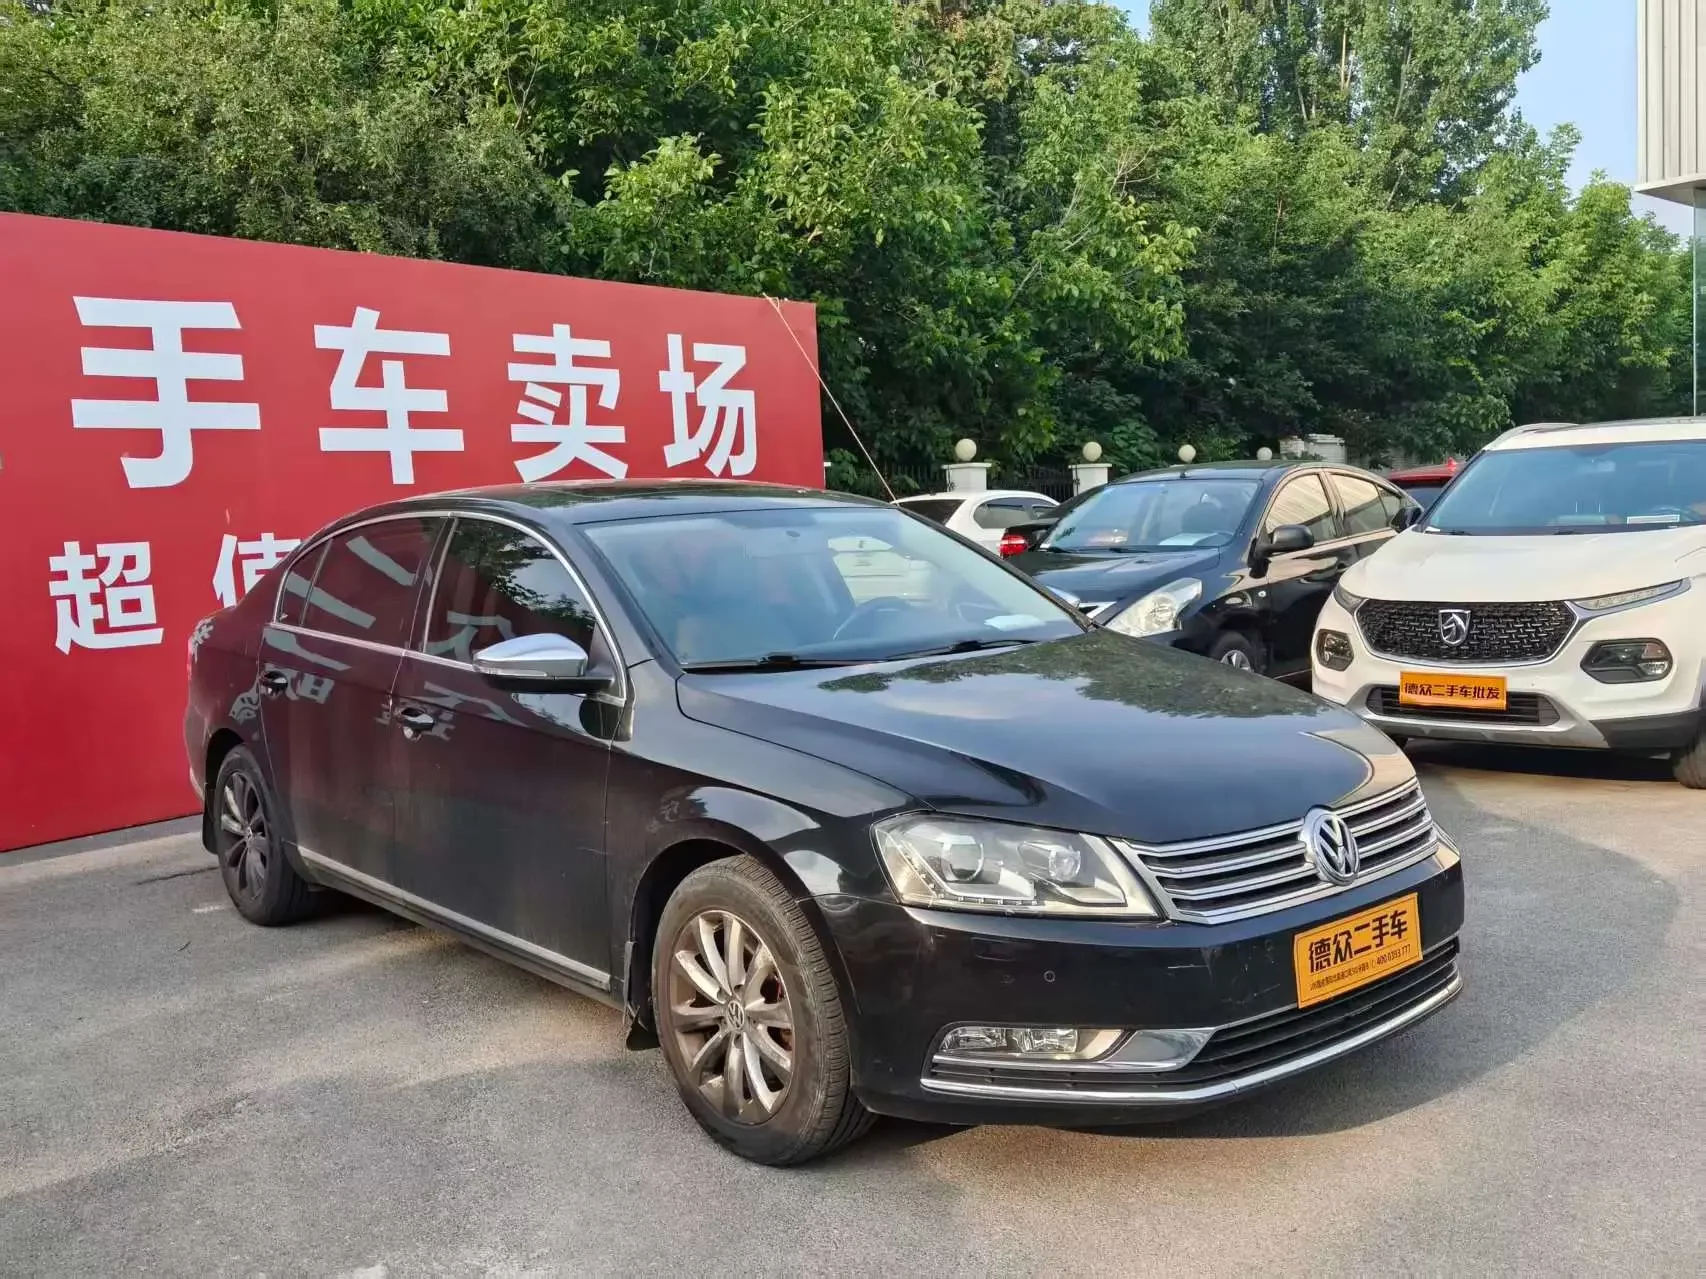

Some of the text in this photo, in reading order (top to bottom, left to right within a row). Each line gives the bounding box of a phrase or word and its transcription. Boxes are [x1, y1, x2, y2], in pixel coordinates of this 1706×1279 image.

[71, 296, 758, 488] 手车卖场
[1405, 683, 1500, 699] 德众二手车批发
[1308, 910, 1408, 973] 德众二手车
